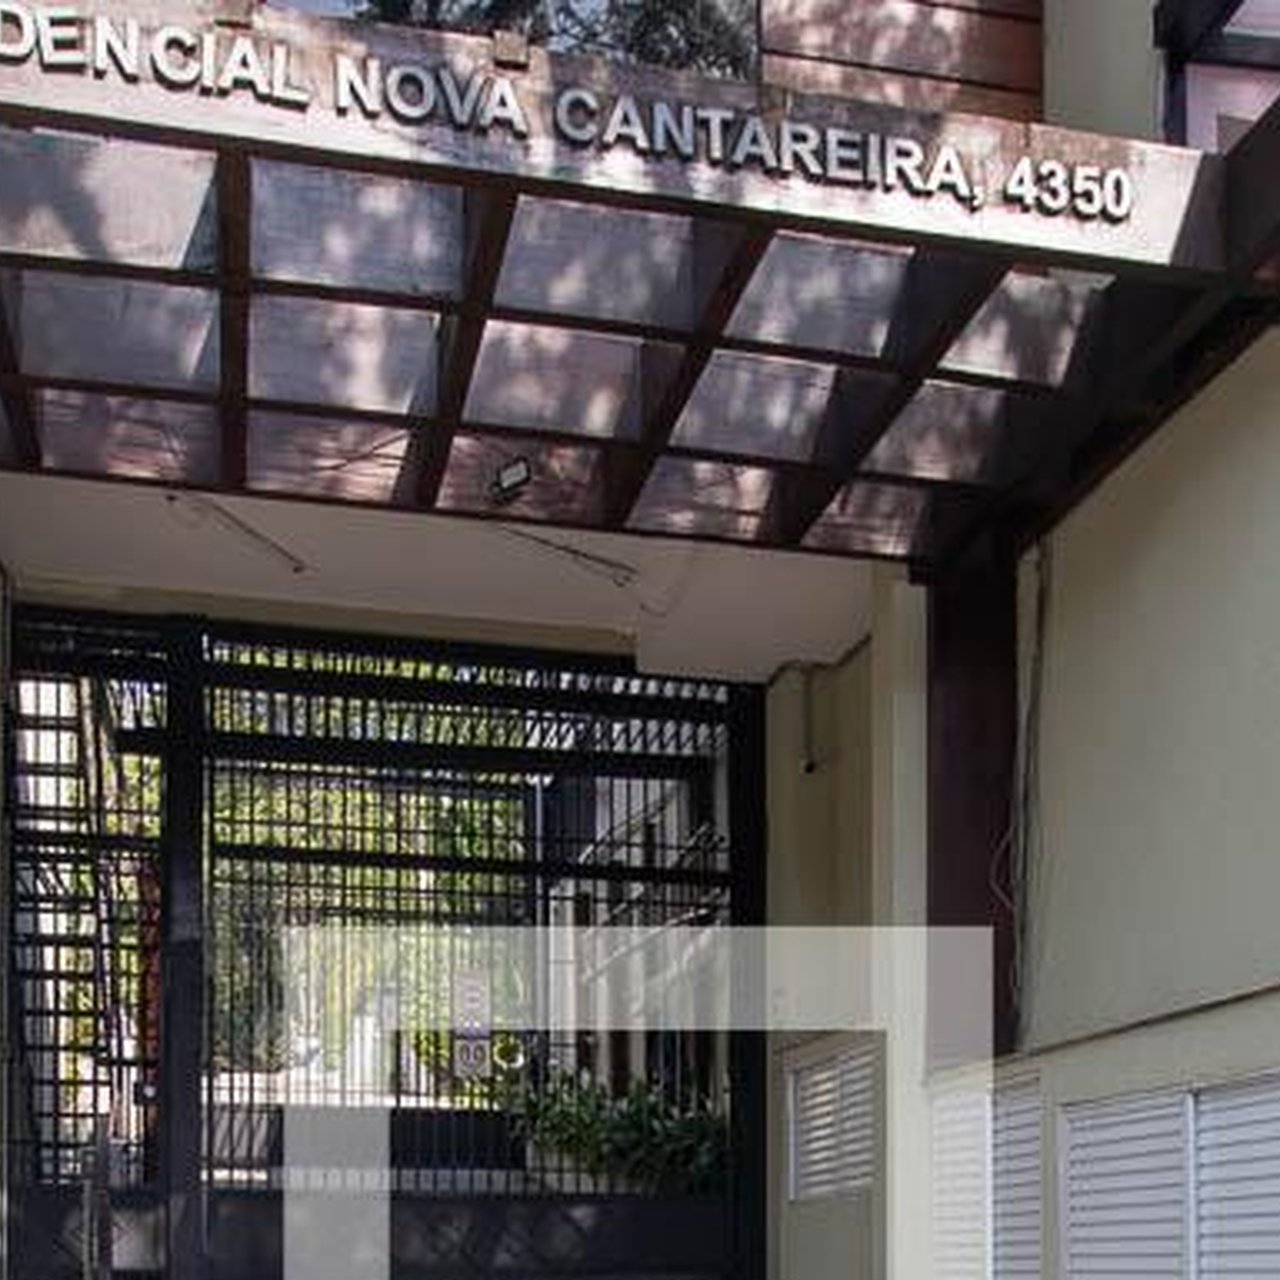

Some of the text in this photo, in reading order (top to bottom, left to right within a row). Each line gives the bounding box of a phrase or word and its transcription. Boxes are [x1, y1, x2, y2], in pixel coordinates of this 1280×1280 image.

[334, 54, 528, 137] NOVA
[554, 88, 986, 210] CANTAREIRA,
[1005, 156, 1132, 223] 4350
